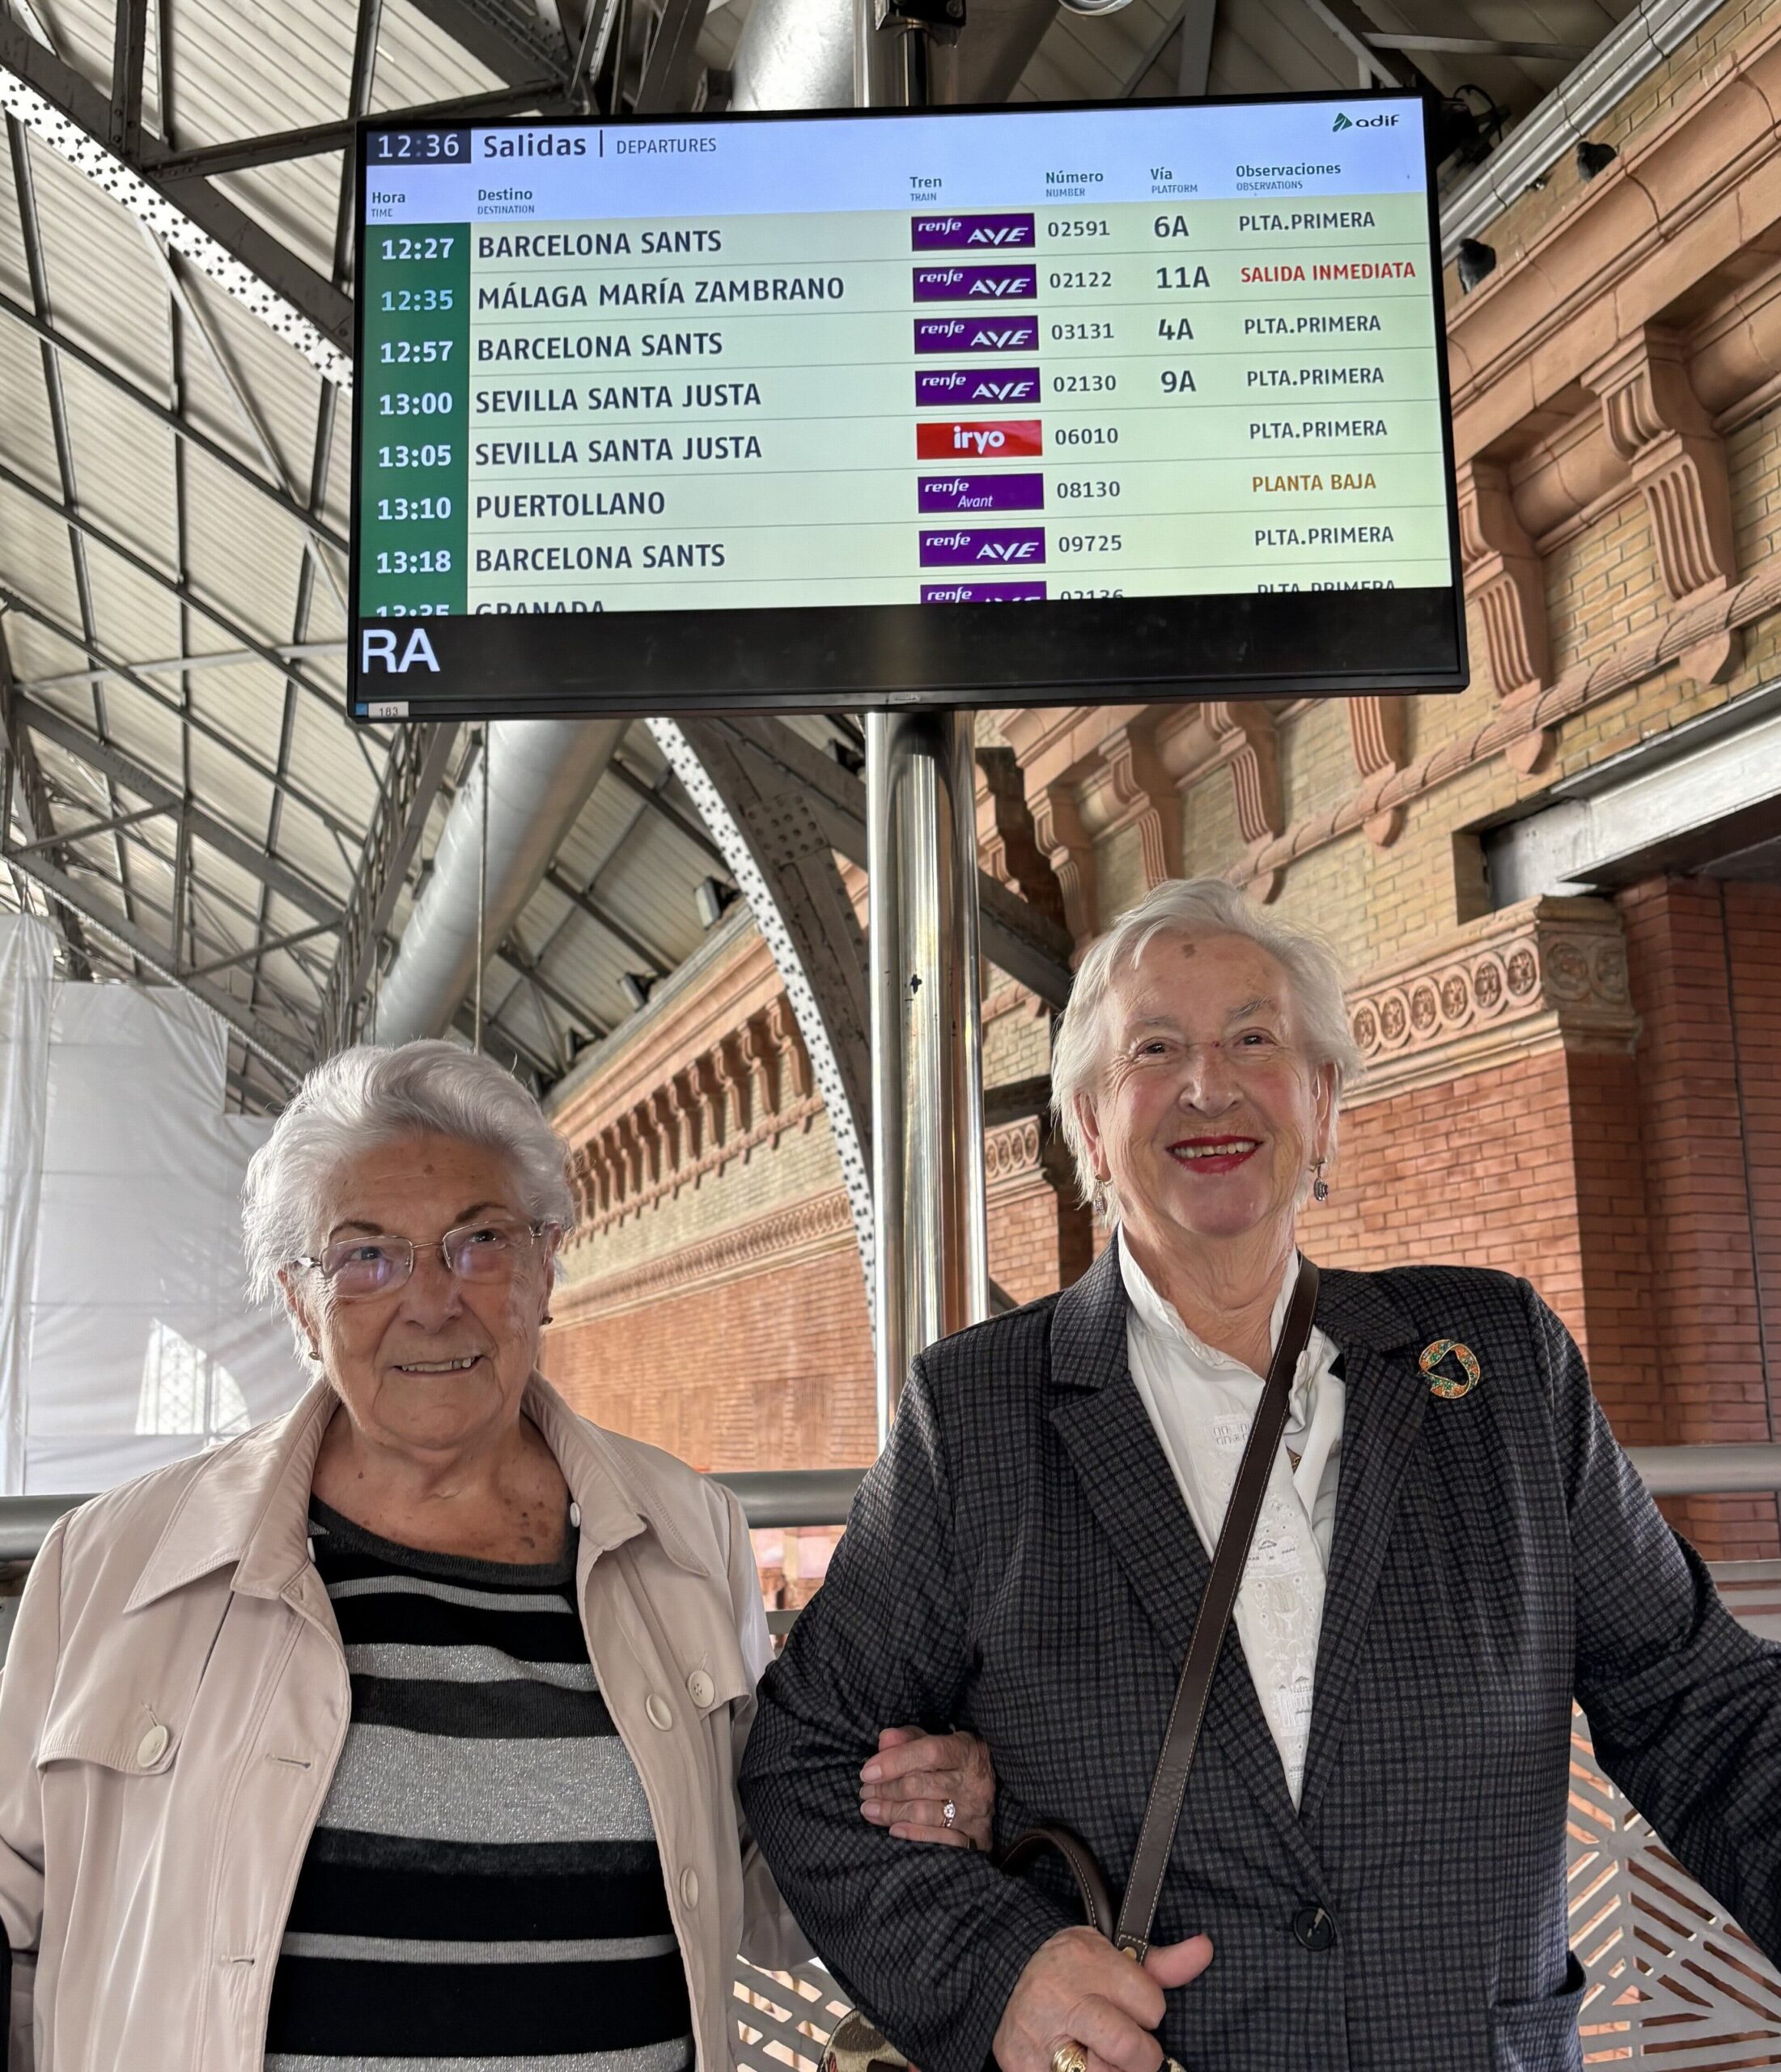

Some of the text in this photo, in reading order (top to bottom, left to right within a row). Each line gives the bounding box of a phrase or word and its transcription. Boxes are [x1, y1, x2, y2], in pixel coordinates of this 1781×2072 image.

[1356, 115, 1399, 127] adif
[379, 134, 459, 157] 12:36
[485, 133, 586, 158] Salidas
[617, 138, 716, 154] DEPARTURES
[1046, 170, 1103, 184] Número
[1151, 167, 1172, 180] Vía
[1236, 163, 1341, 176] Observaciones
[910, 176, 942, 188] Tren
[1151, 185, 1198, 193] PLATFORM
[1236, 180, 1303, 190] OBSERVATIONS
[372, 192, 405, 203] Hora
[478, 188, 532, 201] Destino
[910, 193, 936, 201] TRAIN
[1046, 188, 1085, 197] NUMBER
[371, 209, 392, 217] TIME
[477, 205, 534, 214] DESTINATION
[918, 218, 1028, 245] renfe AVE
[1048, 221, 1109, 236] 02591
[1155, 215, 1189, 237] 6A
[1240, 212, 1375, 231] PLTA.PRIMERA
[382, 238, 454, 260] 12:27
[479, 231, 721, 258] BARCELONA SANTS
[1050, 272, 1111, 288] 02122
[1157, 266, 1210, 288] 11A
[1241, 262, 1415, 282] SALIDA INMEDIATA
[919, 270, 1031, 296] renfe AVE
[382, 290, 452, 311] 12:35
[479, 278, 843, 309] MÁLAGA MARÍA ZAMBRANO
[920, 321, 1033, 348] renfe AVE
[1052, 323, 1113, 340] 03131
[1159, 319, 1194, 340] 4A
[1245, 316, 1380, 334] PLTA.PRIMERA
[381, 341, 452, 363] 12:57
[478, 333, 722, 360] BARCELONA SANTS
[922, 372, 1034, 401] renfe AVE
[1054, 376, 1116, 392] 02130
[1161, 371, 1196, 393] 9A
[1248, 367, 1384, 386] PLTA.PRIMERA
[380, 393, 452, 415] 13:00
[477, 384, 761, 413] SEVILLA SANTA JUSTA
[1055, 428, 1117, 444] 06010
[1250, 420, 1387, 439] PLTA.PRIMERA
[953, 426, 1005, 454] iryo
[380, 445, 451, 467] 13:05
[476, 436, 761, 465] SEVILLA SANTA JUSTA
[1058, 482, 1120, 498] 08130
[1253, 473, 1376, 492] PLANTA BAJA
[924, 478, 994, 508] renfe Avant
[379, 497, 451, 520] 13:10
[477, 492, 664, 518] PUERTOLLANO
[1059, 535, 1122, 552] 09725
[1256, 526, 1393, 546] PLTA.PRIMERA
[926, 533, 1039, 561] renfe AVE
[377, 550, 451, 573] 13:18
[477, 544, 724, 571] BARCELONA SANTS
[927, 586, 973, 603] renfe
[363, 628, 440, 673] RA
